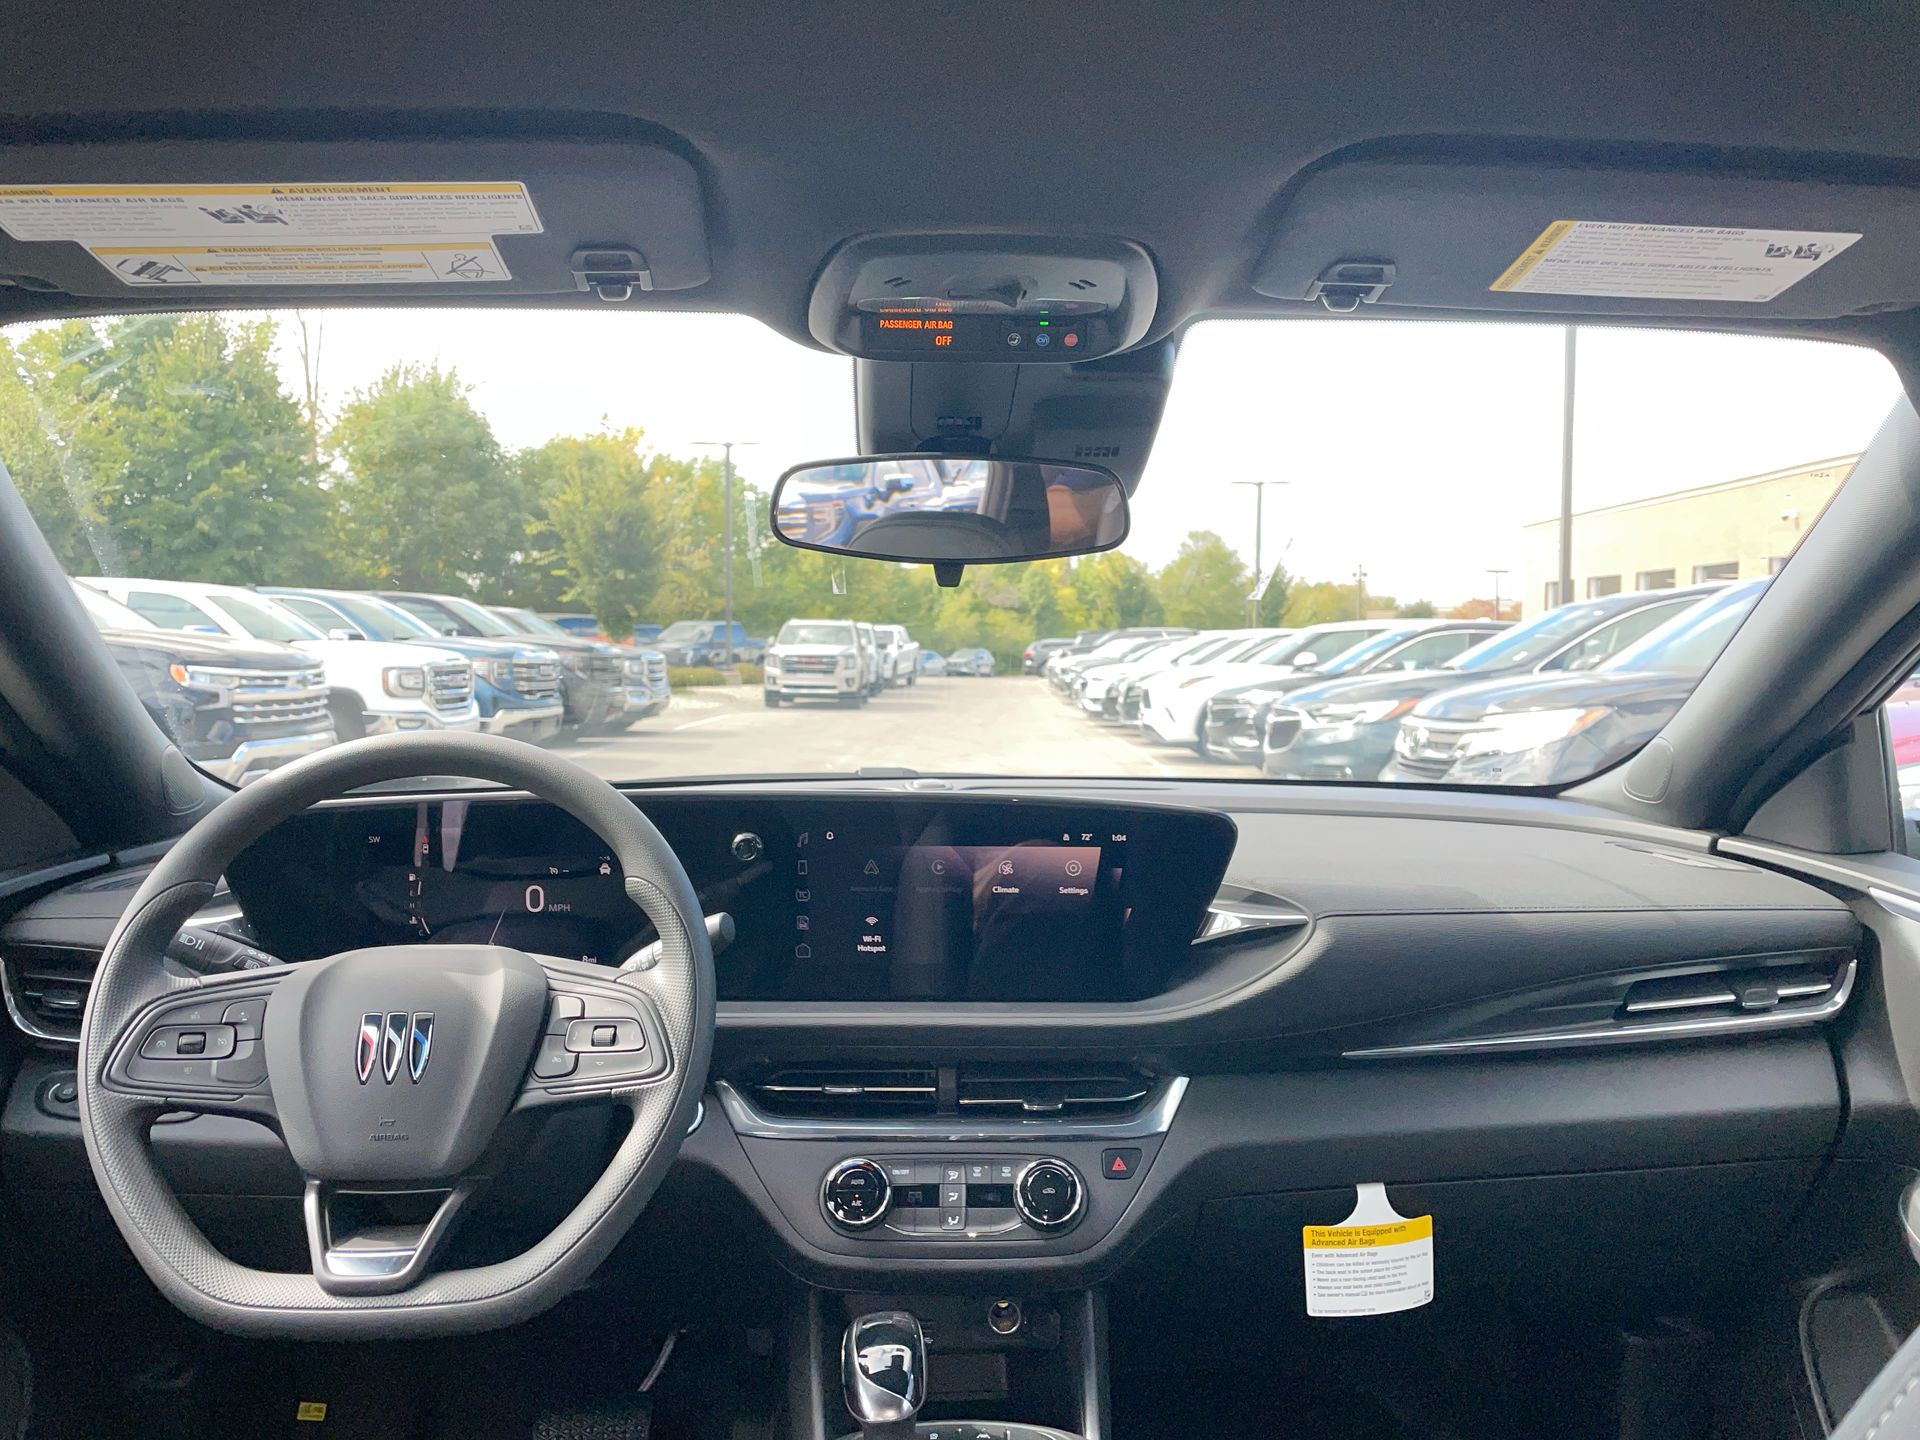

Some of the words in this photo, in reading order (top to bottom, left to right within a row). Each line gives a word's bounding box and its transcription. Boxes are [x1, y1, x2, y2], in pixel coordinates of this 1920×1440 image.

[880, 319, 922, 329] PASSENGER
[924, 320, 937, 329] AIR
[938, 320, 953, 329] BAG
[935, 335, 953, 346] OFF
[1111, 834, 1127, 842] 1:04
[992, 886, 1020, 894] Climate
[1059, 886, 1089, 896] Settings
[525, 884, 545, 913] 0
[548, 903, 571, 912] MPH
[862, 935, 882, 943] Wi-Fi
[857, 944, 887, 953] Hotspot
[369, 1133, 409, 1142] AIRBAG
[1311, 1229, 1326, 1237] This
[1327, 1229, 1353, 1237] Vehicle
[1354, 1229, 1361, 1237] is
[1362, 1227, 1393, 1236] Equipped
[1393, 1225, 1407, 1233] with
[1347, 1238, 1357, 1246] Air
[1359, 1238, 1376, 1247] Bags
